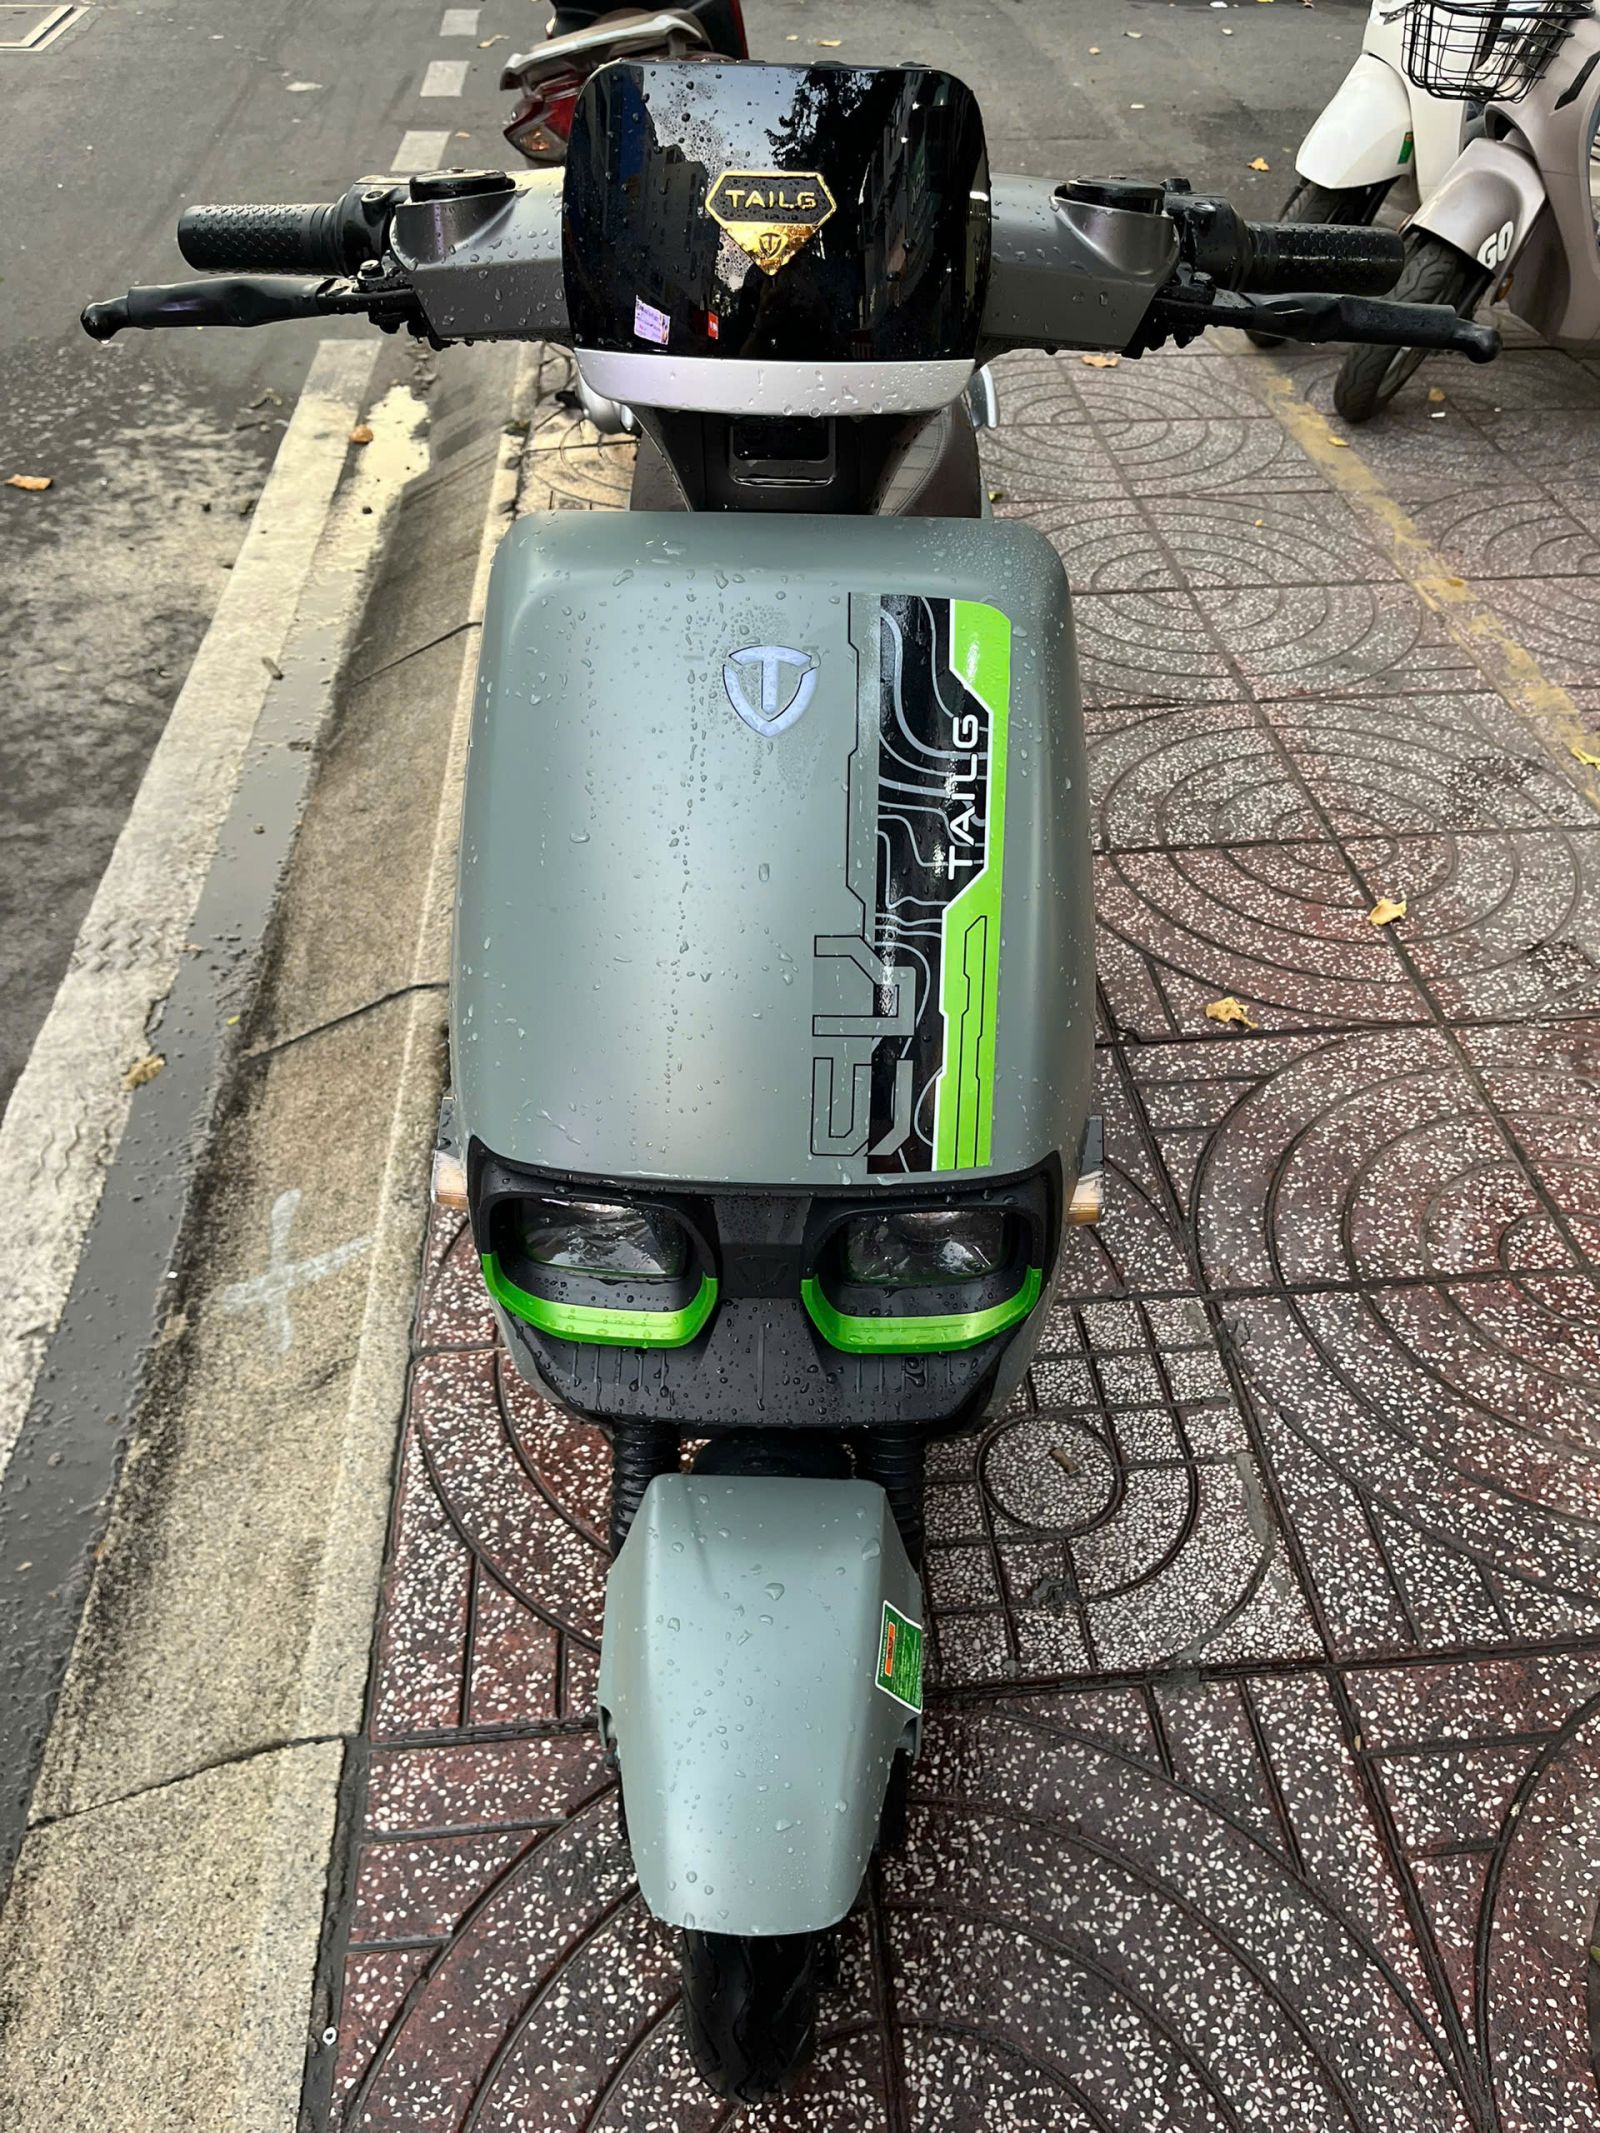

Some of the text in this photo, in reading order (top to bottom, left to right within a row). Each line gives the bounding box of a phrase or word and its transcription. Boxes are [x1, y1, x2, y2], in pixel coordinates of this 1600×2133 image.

[725, 189, 817, 210] TAILG
[1476, 220, 1514, 270] GO
[947, 713, 980, 881] TAILG
